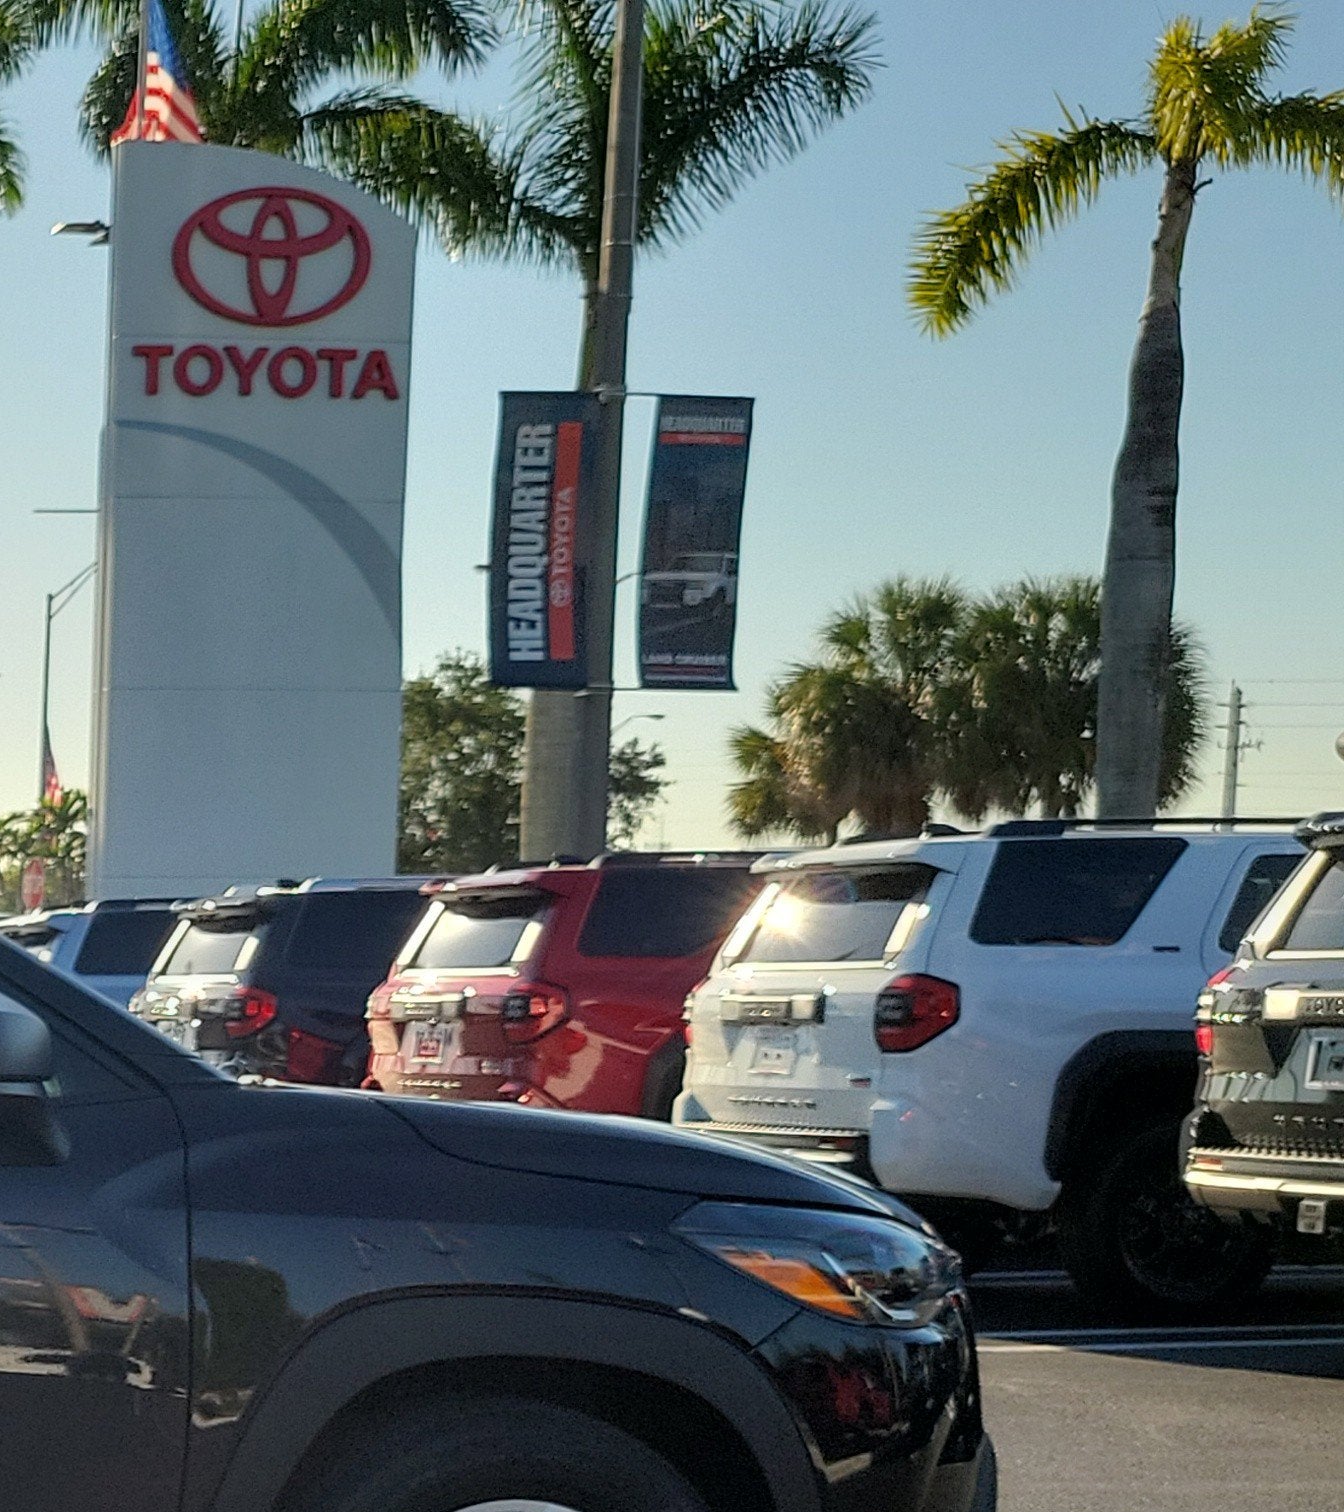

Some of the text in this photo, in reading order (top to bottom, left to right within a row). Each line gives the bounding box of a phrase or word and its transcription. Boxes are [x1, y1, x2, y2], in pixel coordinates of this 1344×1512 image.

[132, 344, 399, 400] TOYOTA
[507, 424, 553, 661] HEADQUARTER
[550, 487, 574, 575] TOYOTA
